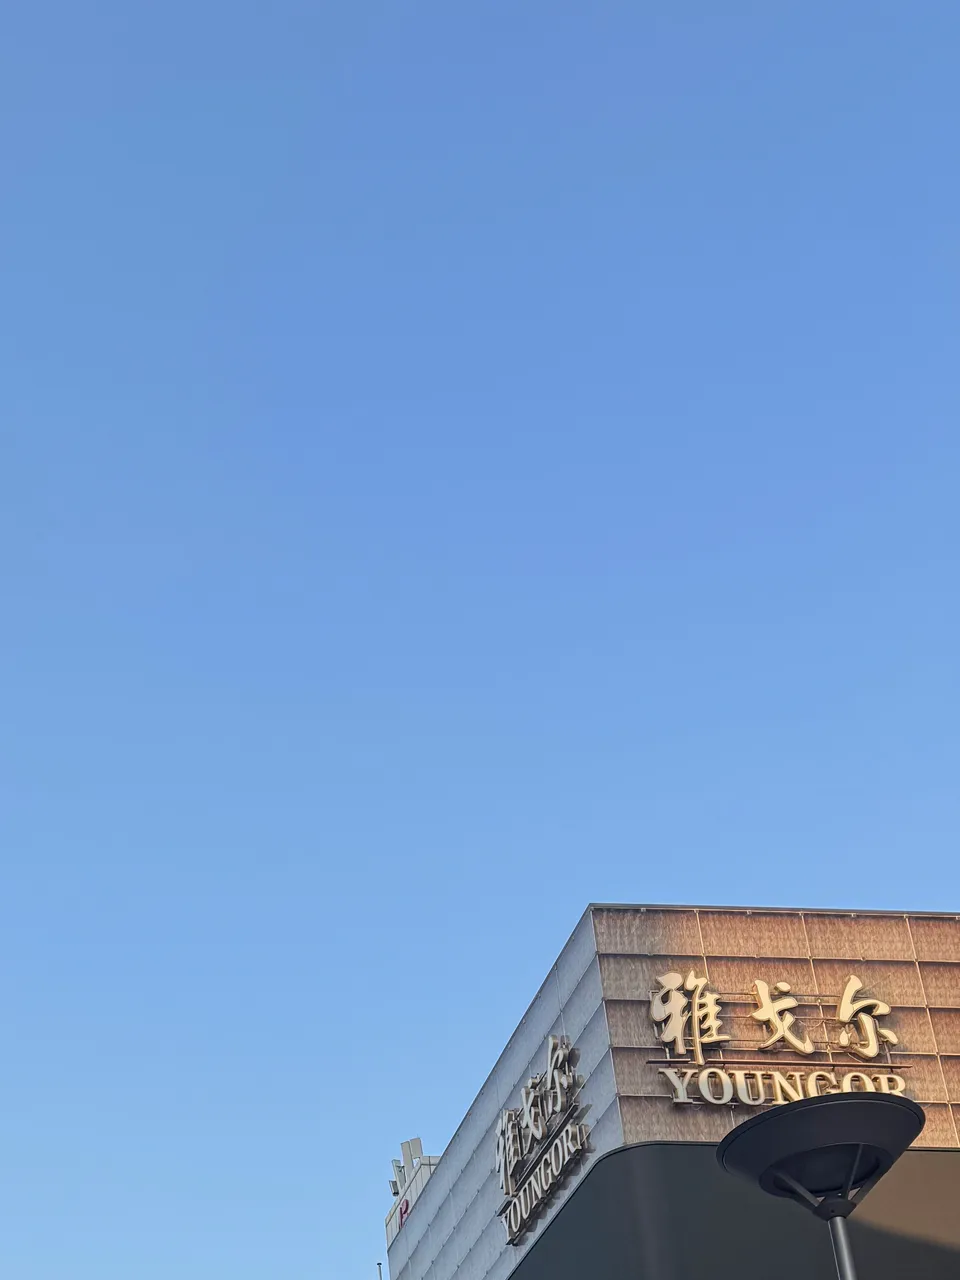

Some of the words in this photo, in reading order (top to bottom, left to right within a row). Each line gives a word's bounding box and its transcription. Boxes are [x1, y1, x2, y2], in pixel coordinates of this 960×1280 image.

[650, 969, 899, 1065] 雅戈尔
[495, 1034, 579, 1197] 雅戈尔
[500, 1124, 585, 1246] YOUNGOR
